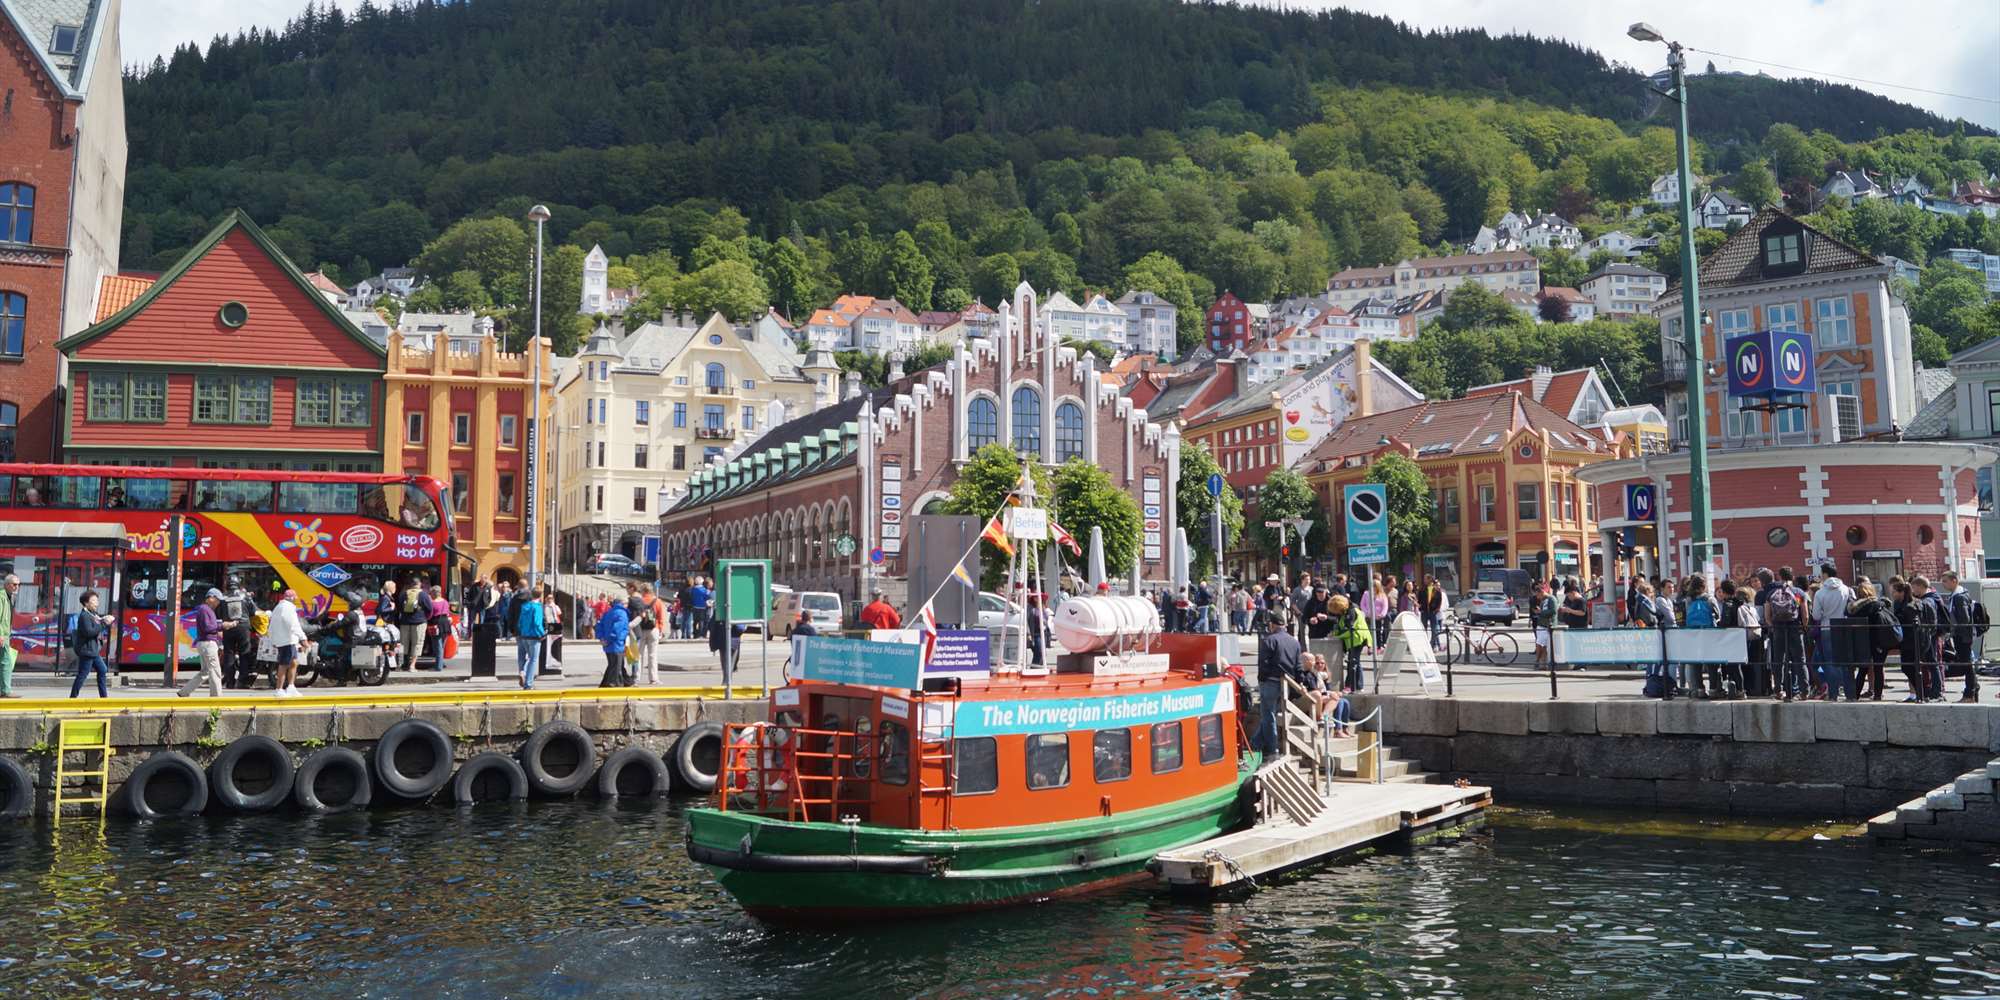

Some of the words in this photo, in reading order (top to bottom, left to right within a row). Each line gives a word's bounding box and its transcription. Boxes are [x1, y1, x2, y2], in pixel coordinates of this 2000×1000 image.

[1742, 354, 1757, 374] N
[1786, 352, 1800, 371] N
[1303, 381, 1315, 395] and
[1637, 495, 1647, 510] N
[397, 535, 417, 545] Hop
[419, 534, 433, 545] On
[397, 548, 417, 559] Hop
[419, 548, 435, 559] Off
[982, 705, 1013, 727] The
[1017, 702, 1099, 728] Norwegian
[1103, 696, 1158, 720] Fisheries
[1161, 692, 1204, 712] Museum
